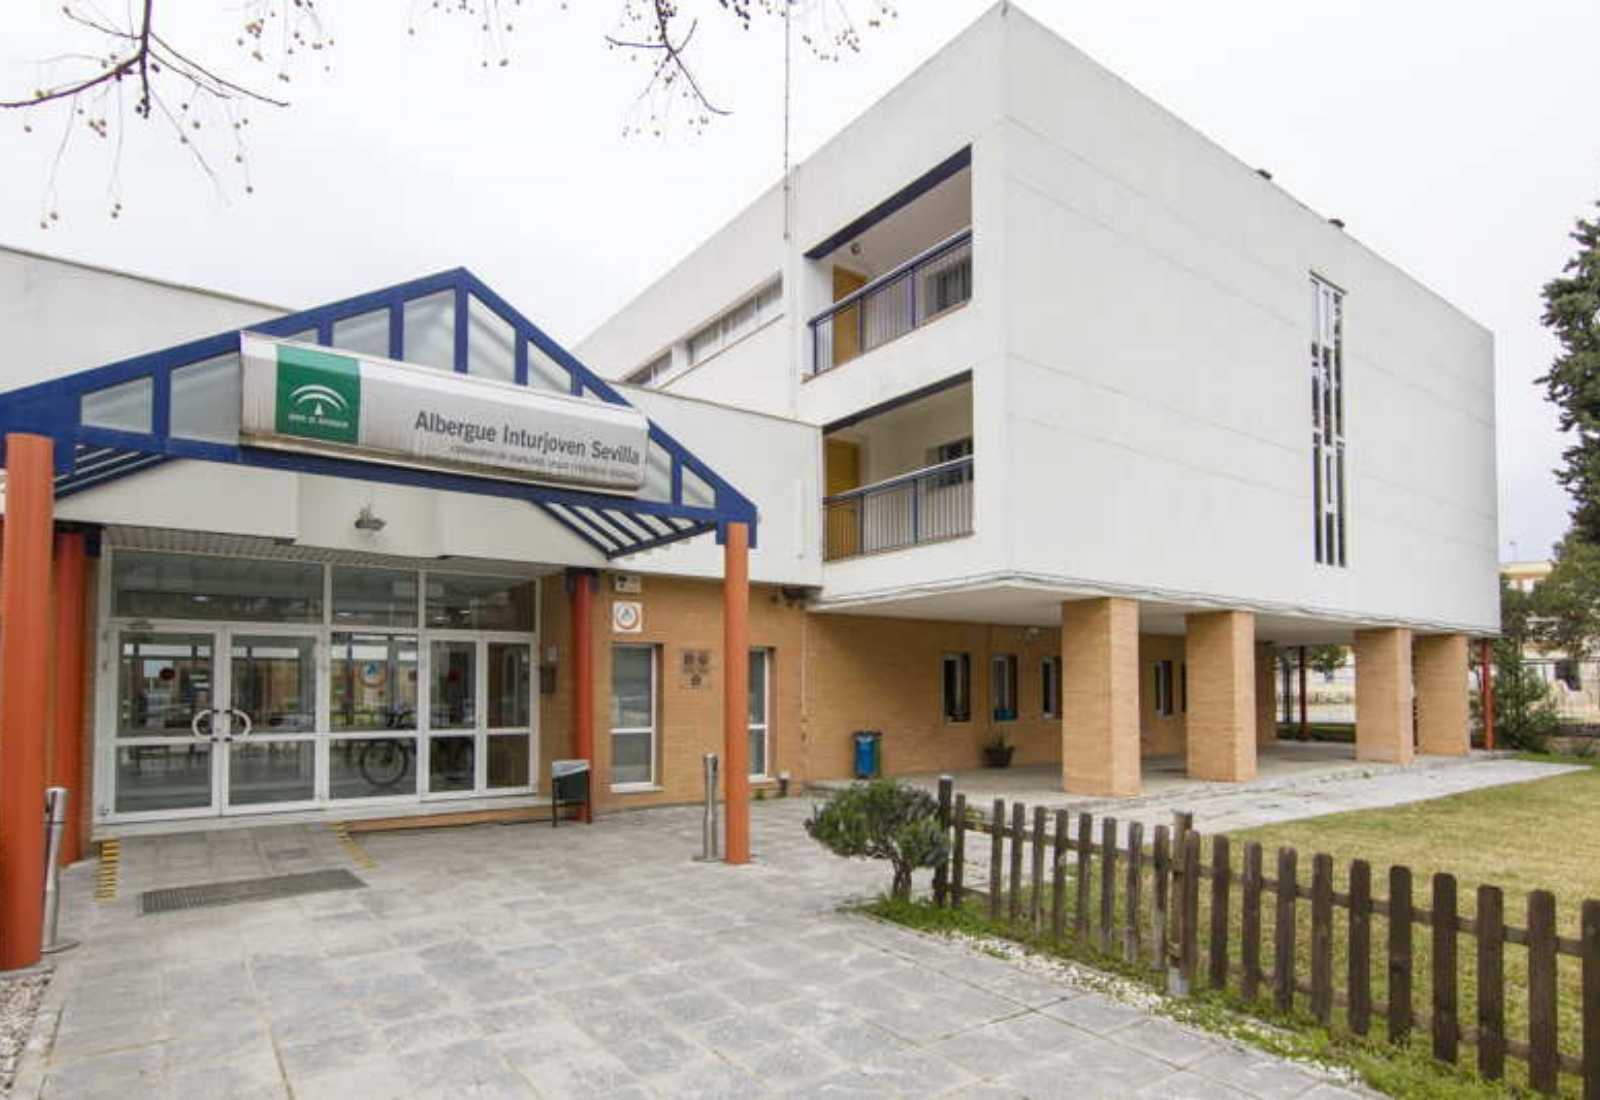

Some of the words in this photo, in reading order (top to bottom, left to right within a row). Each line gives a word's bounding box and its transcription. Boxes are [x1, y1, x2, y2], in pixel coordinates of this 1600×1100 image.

[415, 410, 497, 443] Albergue
[503, 424, 586, 457] Inturjoven
[592, 440, 640, 465] Sevilla
